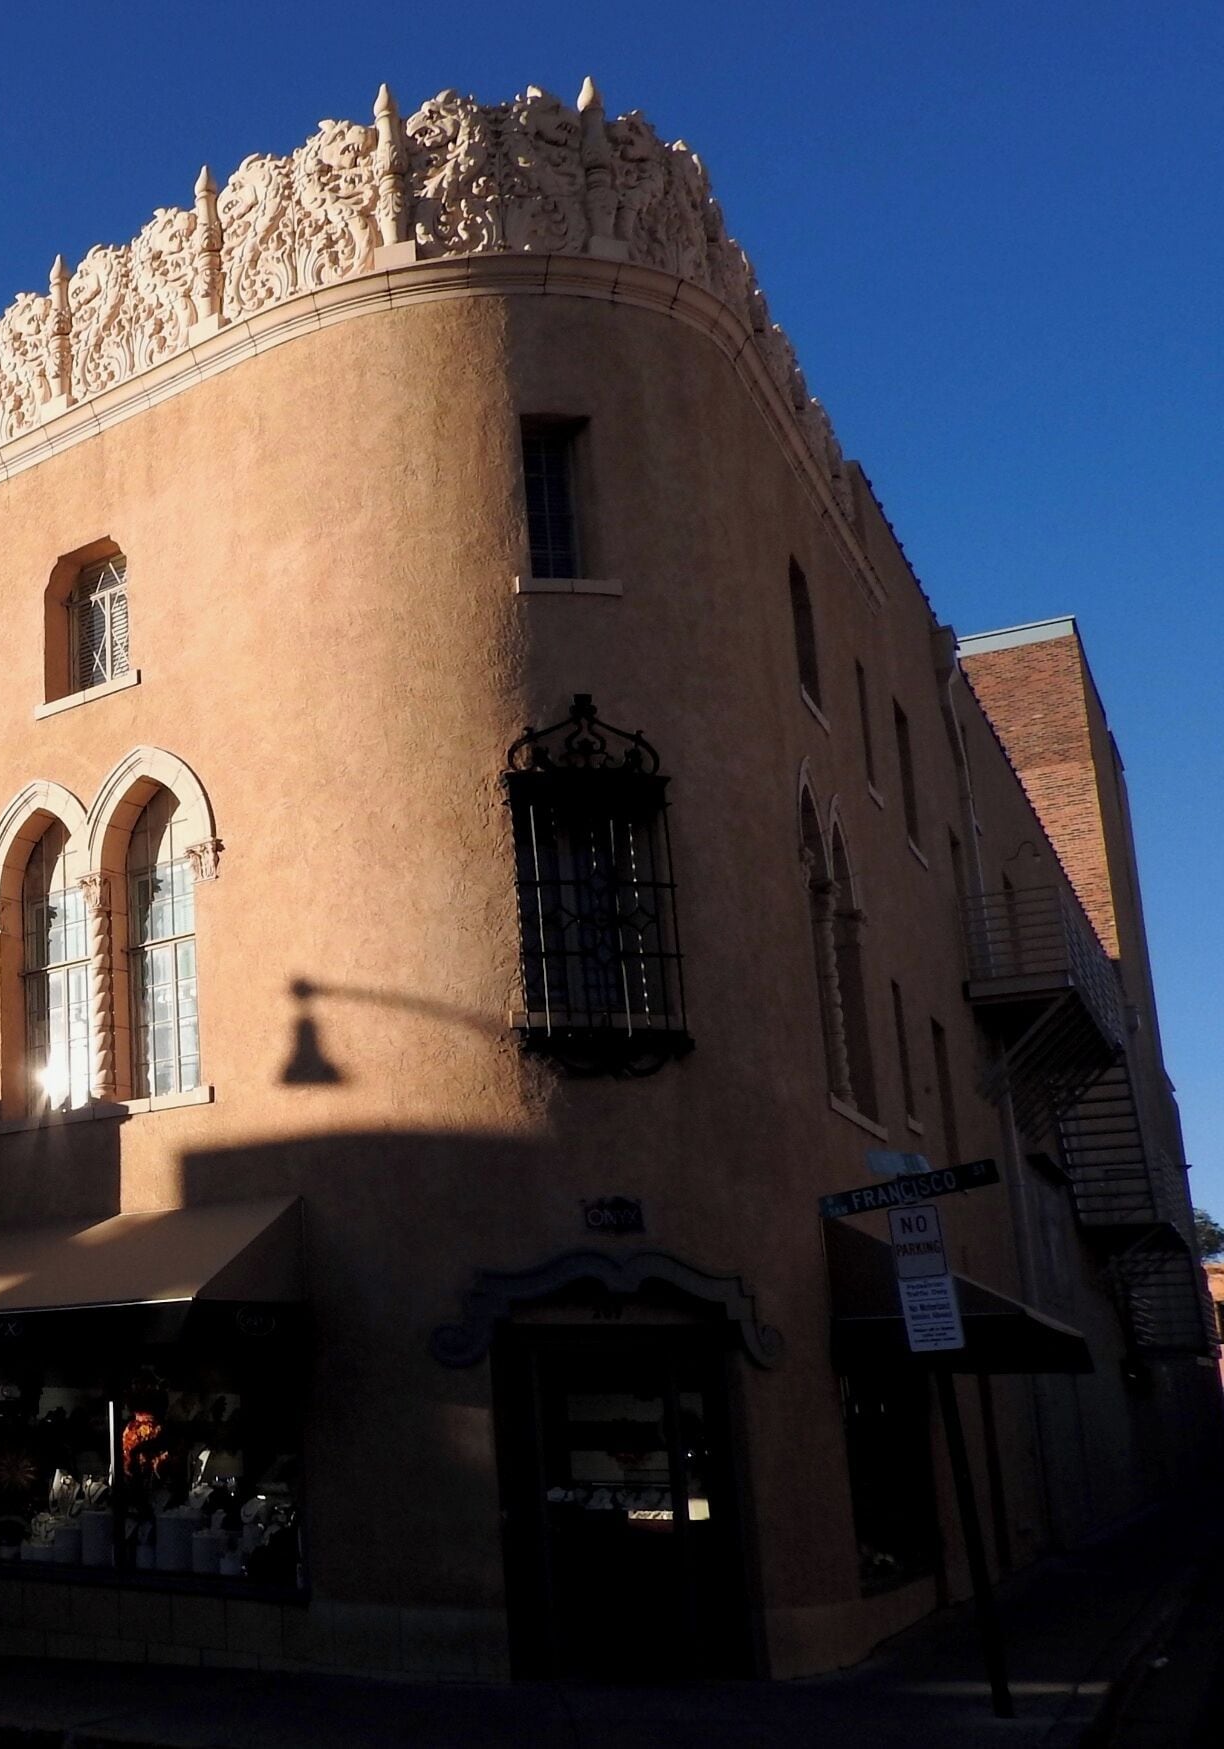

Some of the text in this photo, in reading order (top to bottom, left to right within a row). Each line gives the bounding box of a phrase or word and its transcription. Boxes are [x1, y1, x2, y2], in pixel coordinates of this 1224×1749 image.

[850, 1170, 957, 1211] FRANCISCO
[900, 1214, 928, 1234] NO
[895, 1239, 941, 1257] PARKING
